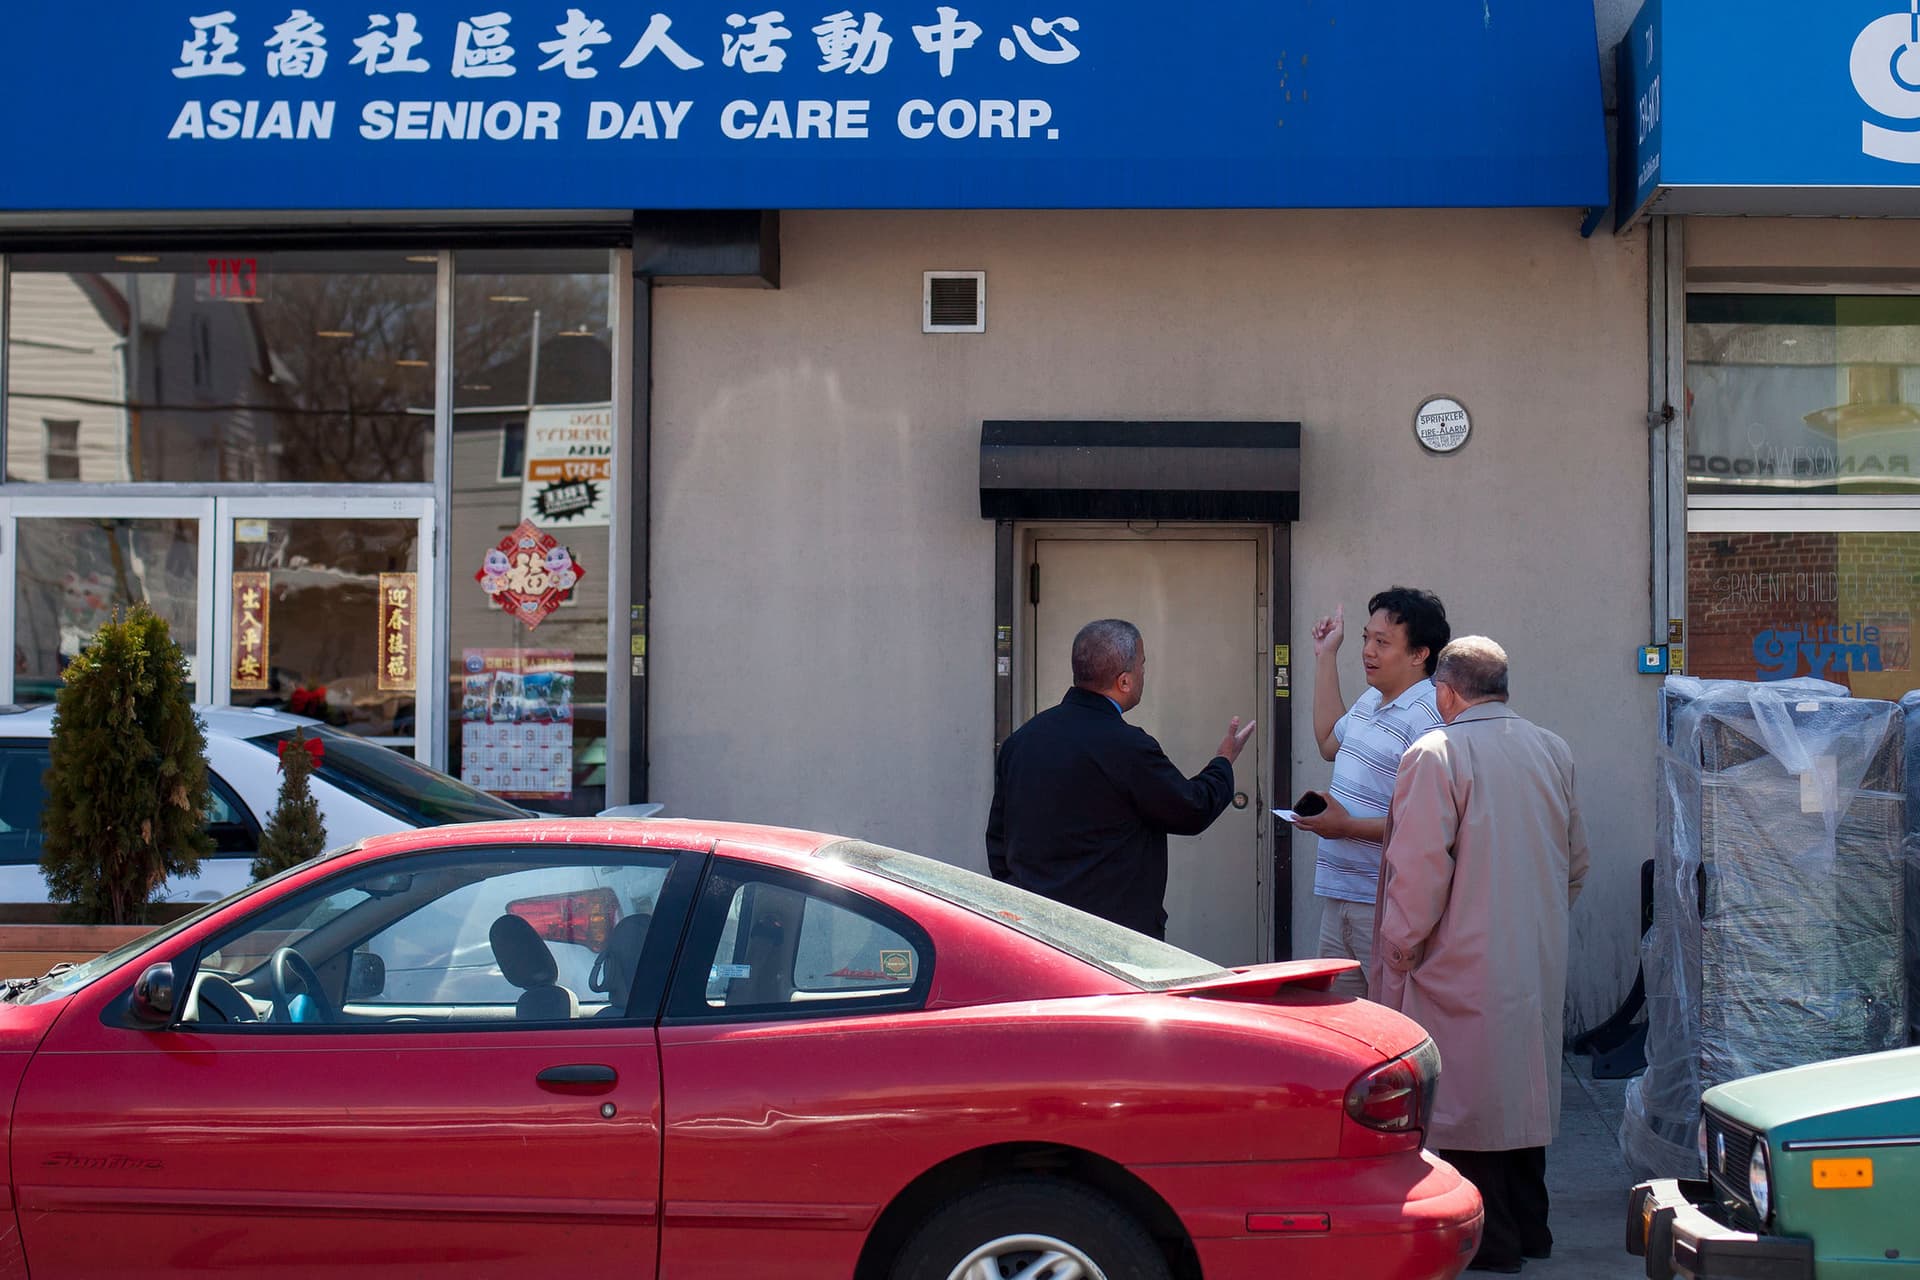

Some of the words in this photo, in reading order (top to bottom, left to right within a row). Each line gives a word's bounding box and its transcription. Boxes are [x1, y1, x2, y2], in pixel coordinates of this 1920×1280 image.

[172, 7, 1080, 78] 亞裔社區老人活動中心
[168, 100, 335, 138] ASIAN
[360, 101, 560, 139] SENIOR
[587, 101, 693, 139] DAY
[721, 100, 869, 139] CARE
[898, 99, 1058, 139] CORP.
[1420, 411, 1464, 425] SPRINKLER
[507, 552, 549, 595] 福
[1731, 573, 1793, 602] PARENT
[1796, 572, 1838, 602] CHILD
[238, 588, 262, 676] 出入平安
[387, 588, 409, 677] 迎春接福
[1753, 629, 1884, 681] gym
[500, 730, 508, 740] 2
[526, 730, 534, 741] 3
[470, 752, 478, 763] 5
[553, 752, 562, 764] 8
[497, 775, 511, 786] 10
